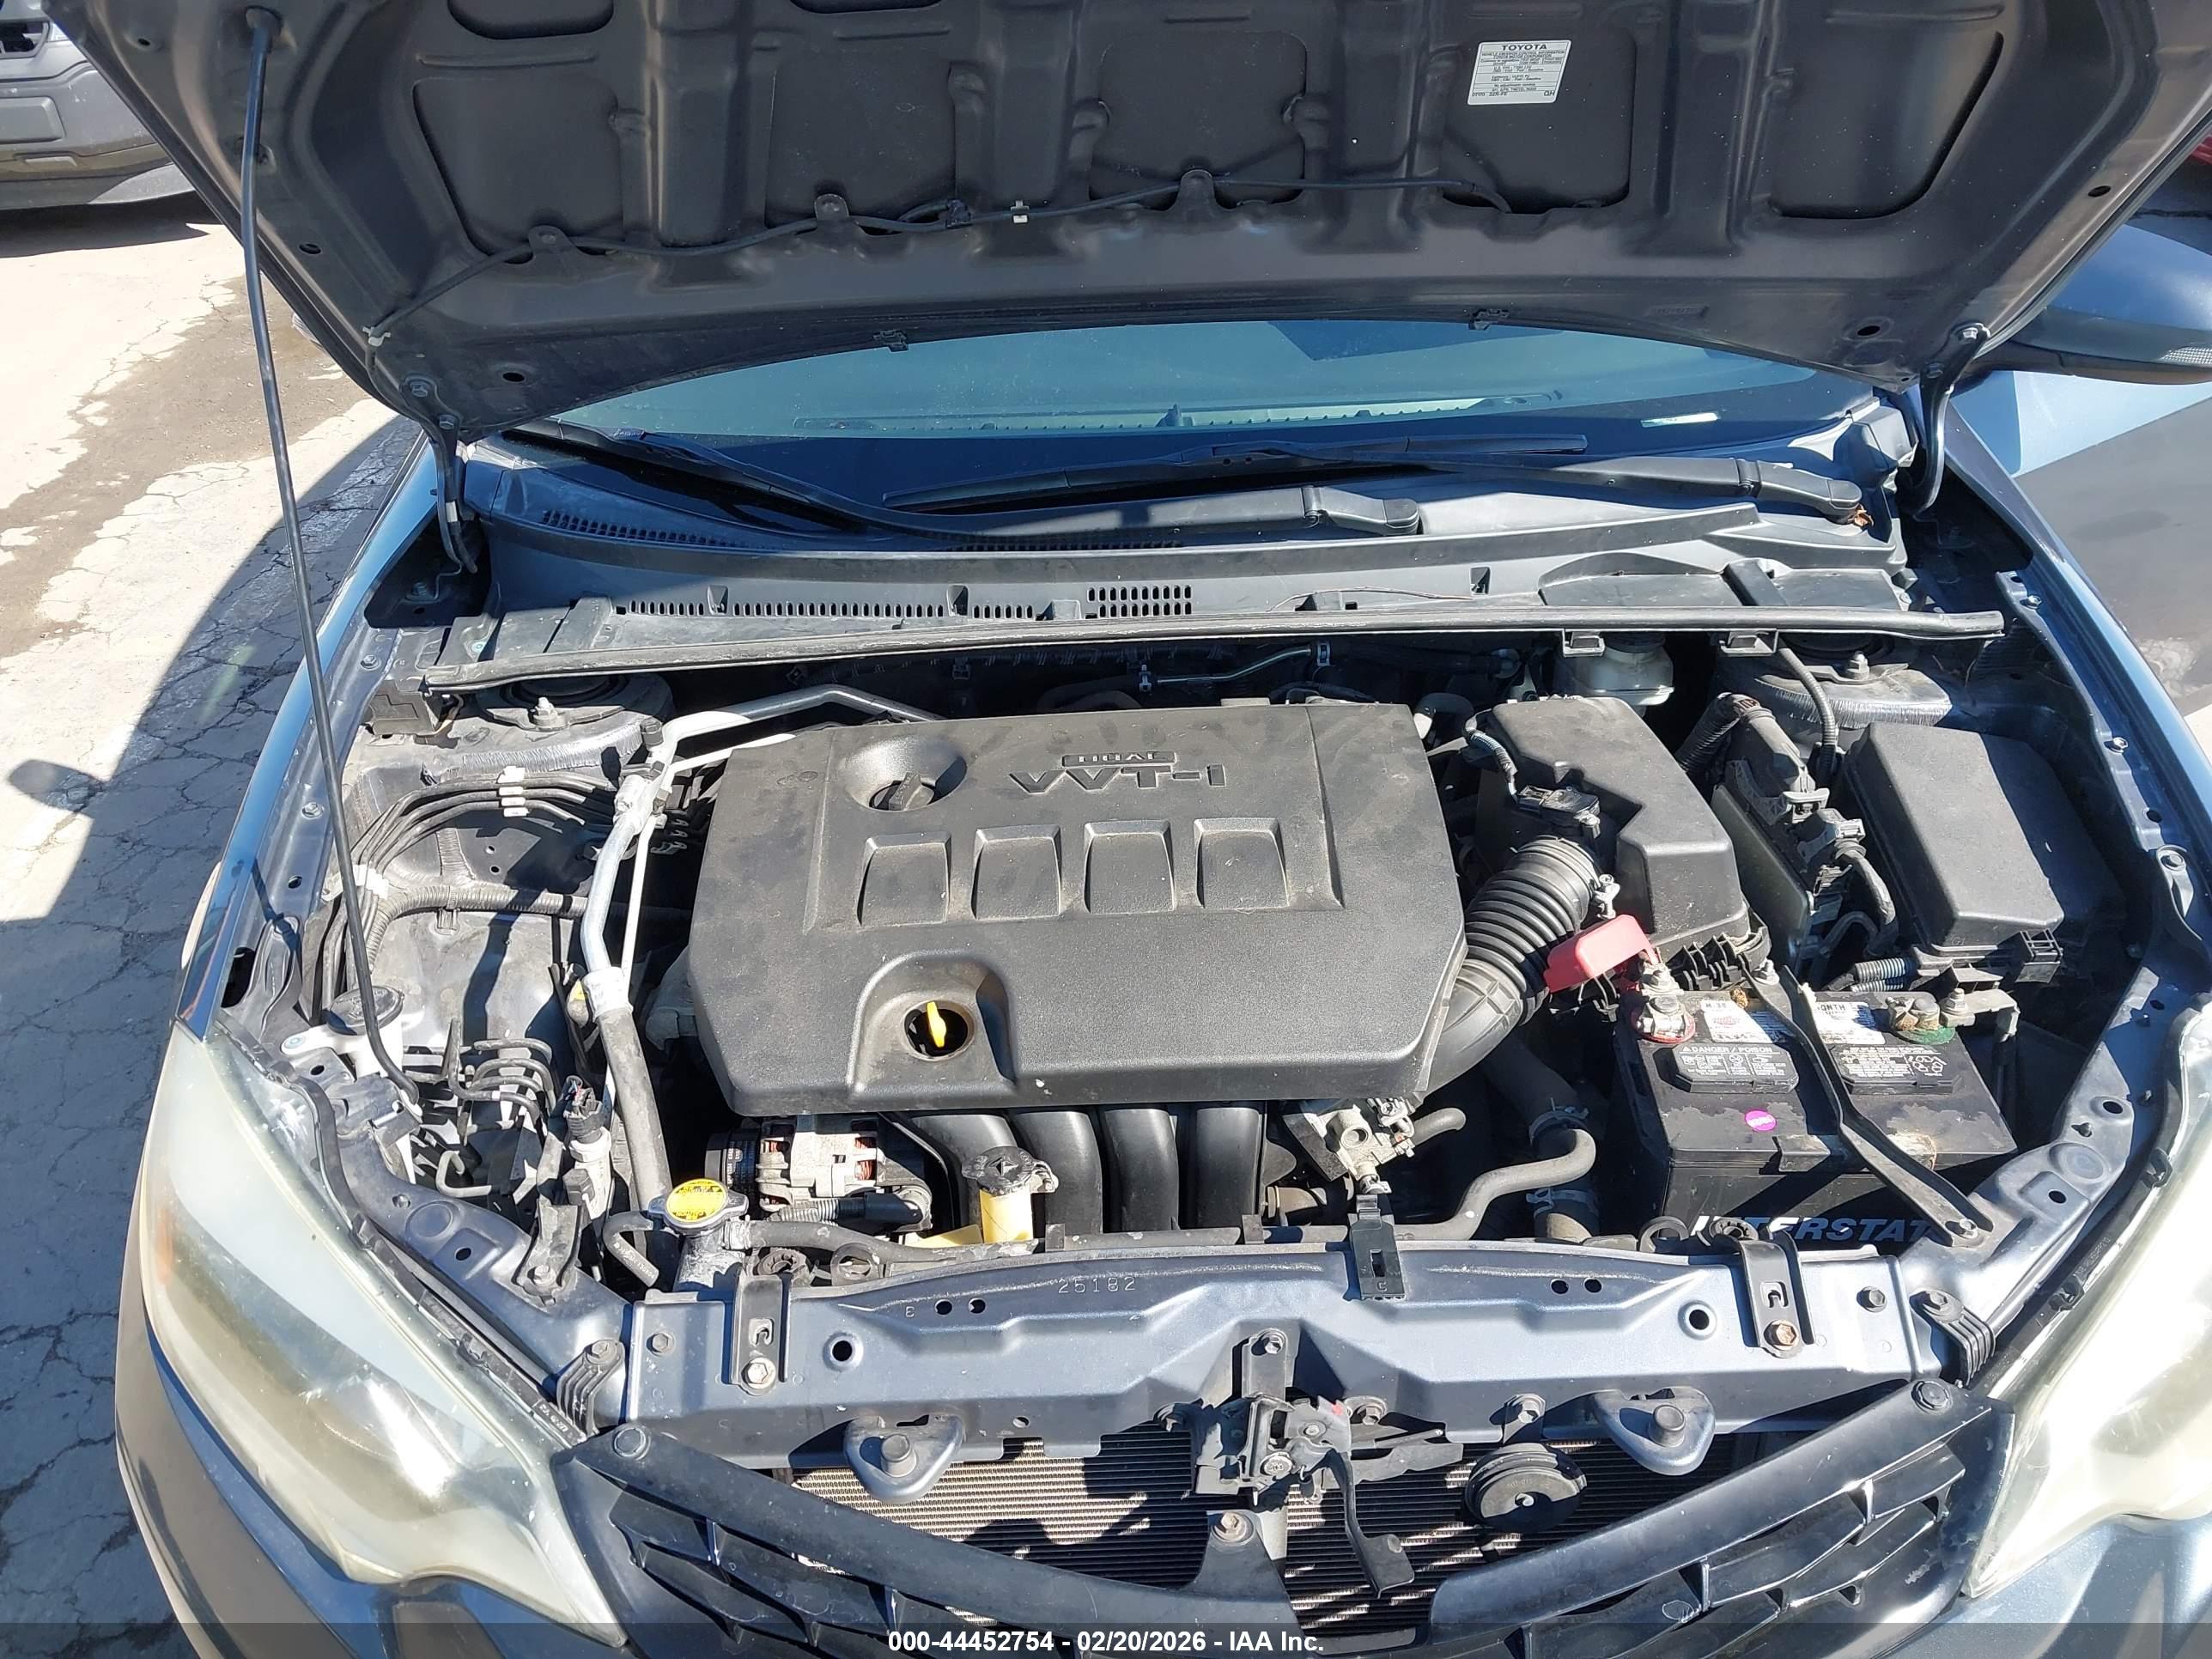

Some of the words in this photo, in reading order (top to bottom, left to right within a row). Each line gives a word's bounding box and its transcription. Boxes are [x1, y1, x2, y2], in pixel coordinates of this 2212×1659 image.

[1065, 751, 1175, 767] DUAL
[1690, 1215, 1932, 1243] ITERSTAT
[1058, 1276, 1136, 1294] 25182
